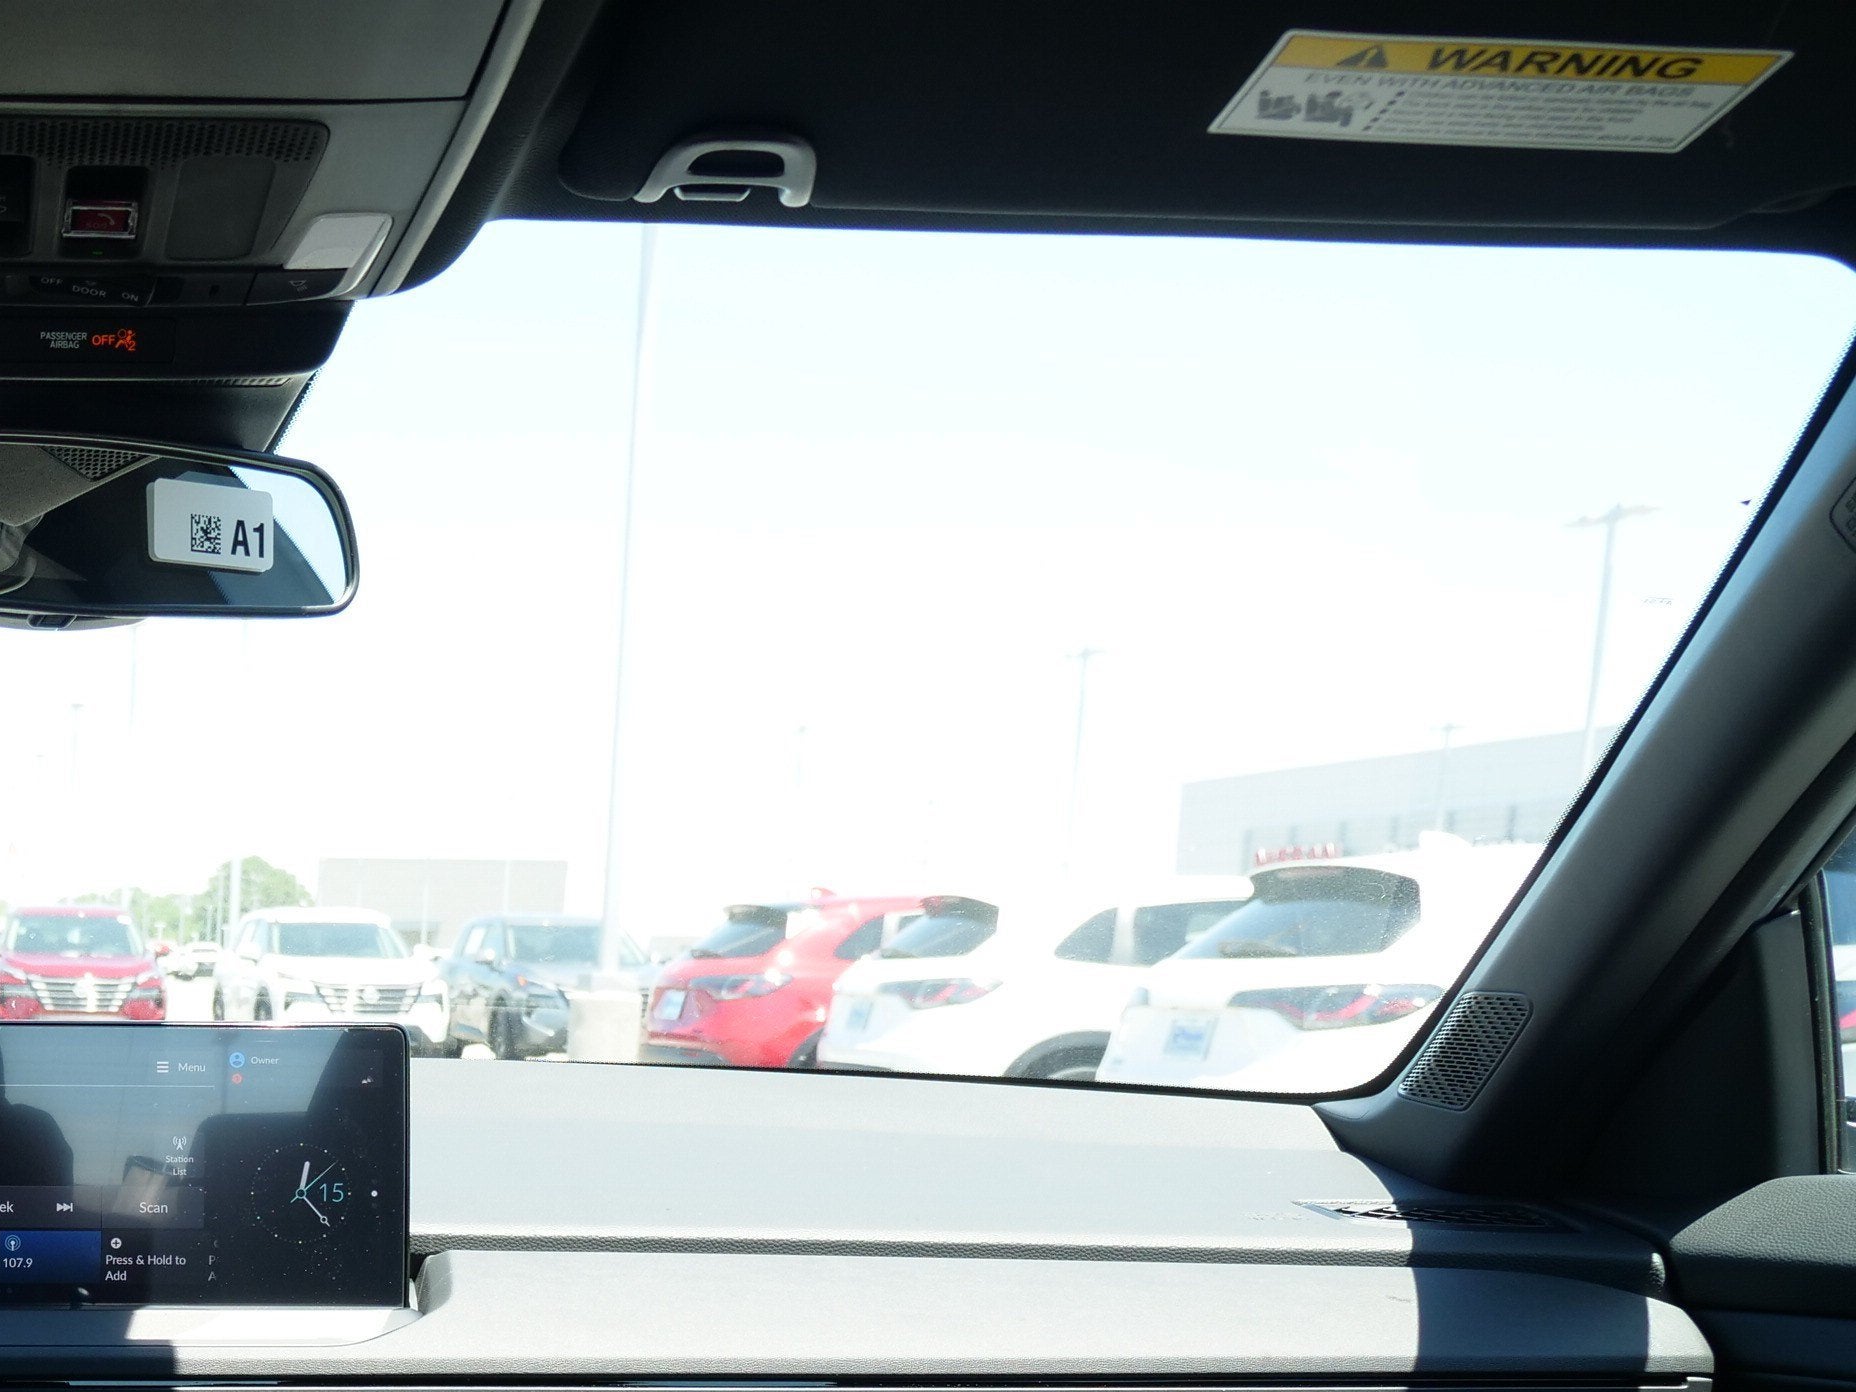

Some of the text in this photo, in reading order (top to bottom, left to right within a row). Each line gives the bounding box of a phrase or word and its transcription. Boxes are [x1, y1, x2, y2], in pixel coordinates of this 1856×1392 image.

[1425, 47, 1704, 78] WARNING
[40, 276, 64, 286] OFF
[72, 285, 107, 298] DOOR
[122, 292, 139, 302] ON
[40, 331, 87, 342] PASSENGER
[91, 335, 116, 346] OFF
[50, 340, 80, 350] AIRBAG
[231, 519, 266, 559] A1
[250, 1056, 279, 1066] Owner
[178, 1062, 206, 1072] Menu
[165, 1155, 194, 1164] Station
[172, 1167, 187, 1176] List
[319, 1183, 344, 1203] 15
[139, 1202, 168, 1214] Scan
[2, 1258, 33, 1269] 107.9
[105, 1255, 186, 1266] Press & Hold to
[105, 1271, 127, 1282] Add
